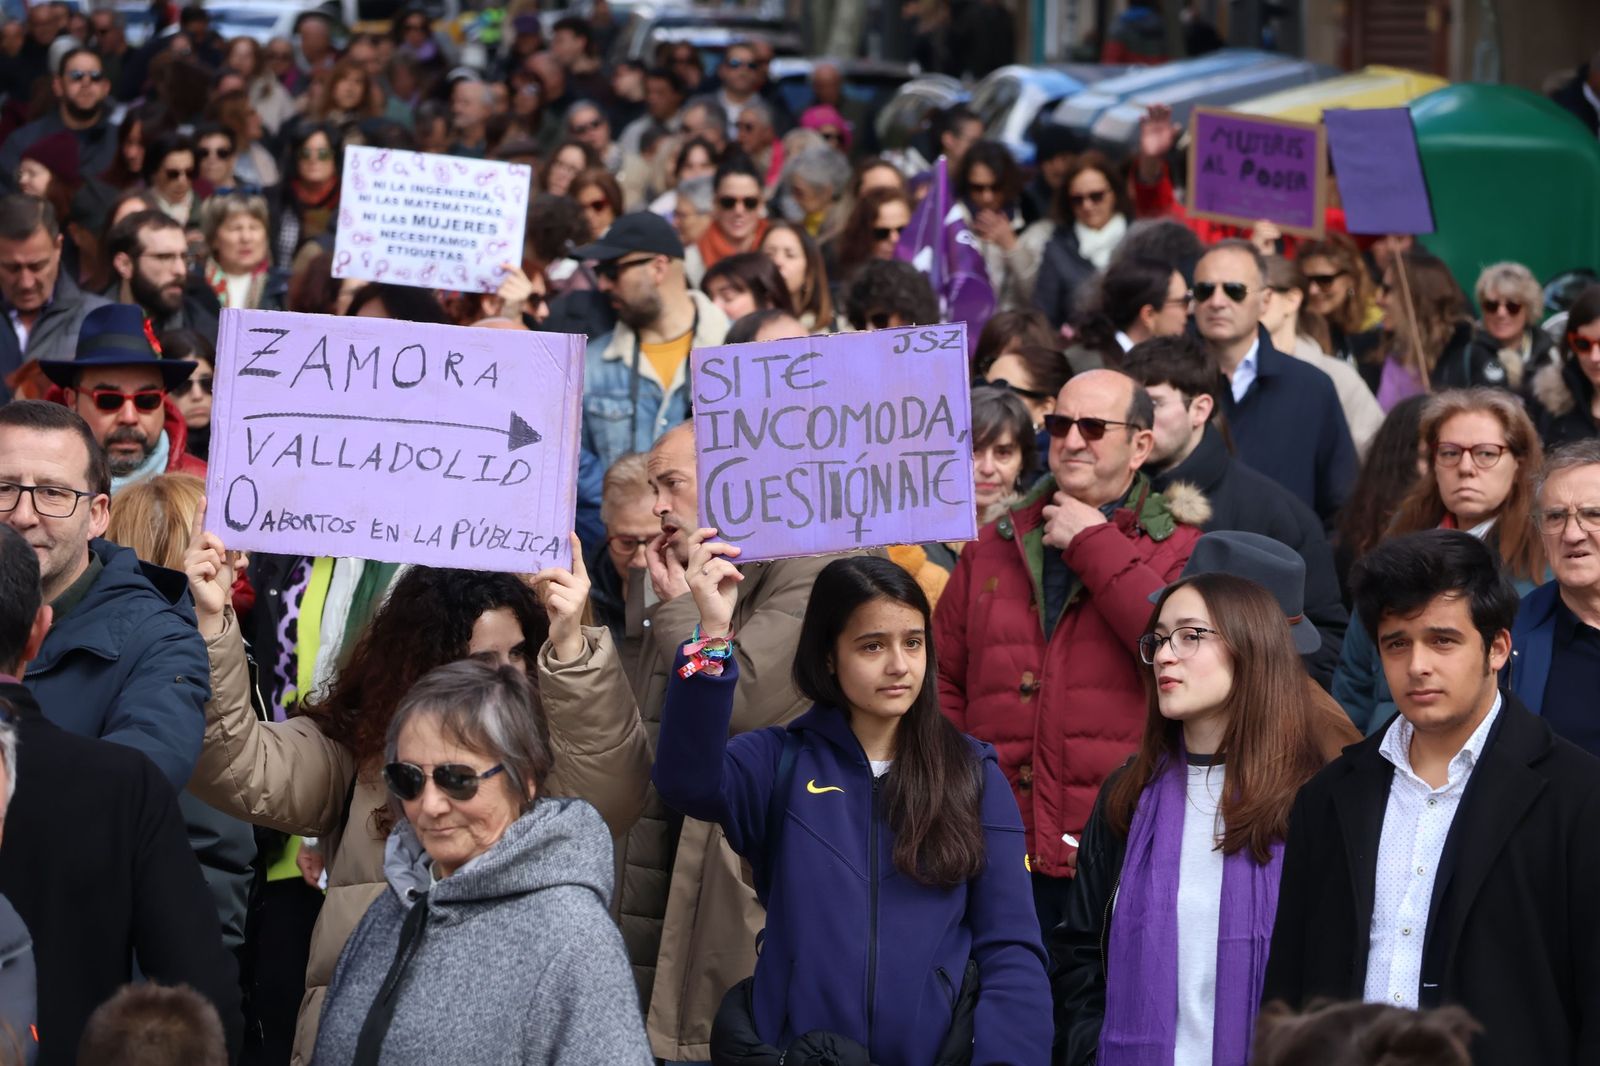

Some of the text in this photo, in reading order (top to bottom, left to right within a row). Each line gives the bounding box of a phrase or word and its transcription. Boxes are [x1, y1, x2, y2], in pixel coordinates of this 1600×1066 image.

[1202, 153, 1228, 176] AL
[373, 181, 386, 190] NI
[391, 182, 406, 192] LA
[359, 193, 372, 202] NI
[376, 195, 399, 206] LAS
[363, 211, 498, 236] NI LAS MUJERES
[380, 229, 477, 250] NECESITAMOS
[893, 329, 962, 354] JSZ
[238, 328, 499, 392] ZAMORA
[698, 394, 968, 453] INCOMODA,
[247, 427, 531, 486] VALLADOLID
[705, 450, 968, 542] CUESTIÓNATE
[259, 508, 356, 533] ABORTOS
[370, 517, 400, 543] EN
[413, 524, 441, 547] LA
[451, 518, 561, 560] PÚBLICA
